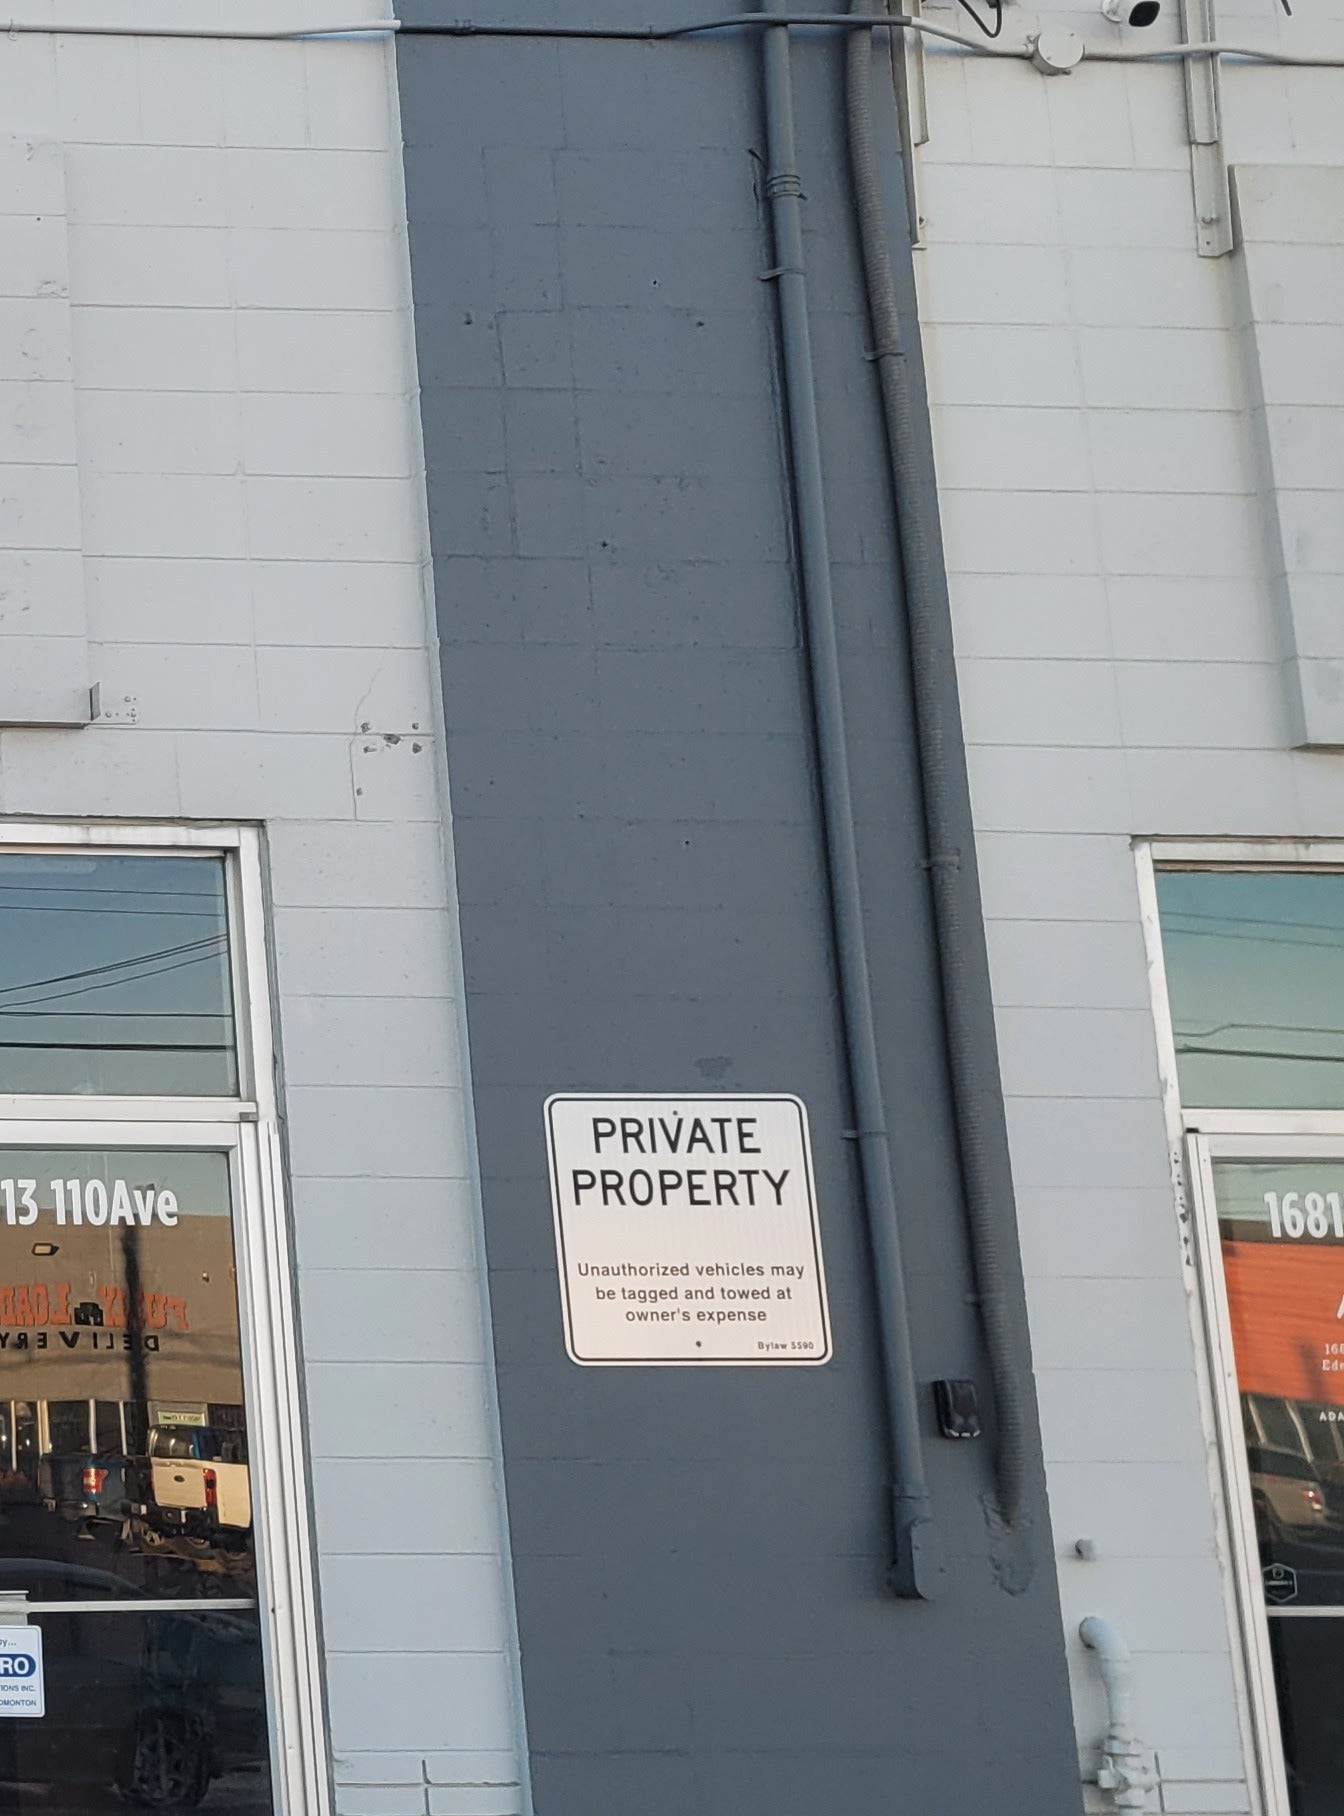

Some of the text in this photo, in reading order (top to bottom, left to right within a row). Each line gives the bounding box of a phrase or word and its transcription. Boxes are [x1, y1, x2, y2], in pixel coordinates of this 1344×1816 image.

[591, 1116, 762, 1154] PRIVATE
[571, 1168, 790, 1206] PROPERTY
[50, 1178, 179, 1227] 110Ave
[577, 1262, 805, 1280] Unauthorized vehicles may
[595, 1286, 792, 1304] be tagged and towed at
[625, 1307, 767, 1325] owner's expense
[757, 1340, 815, 1352] Bylaw 5590
